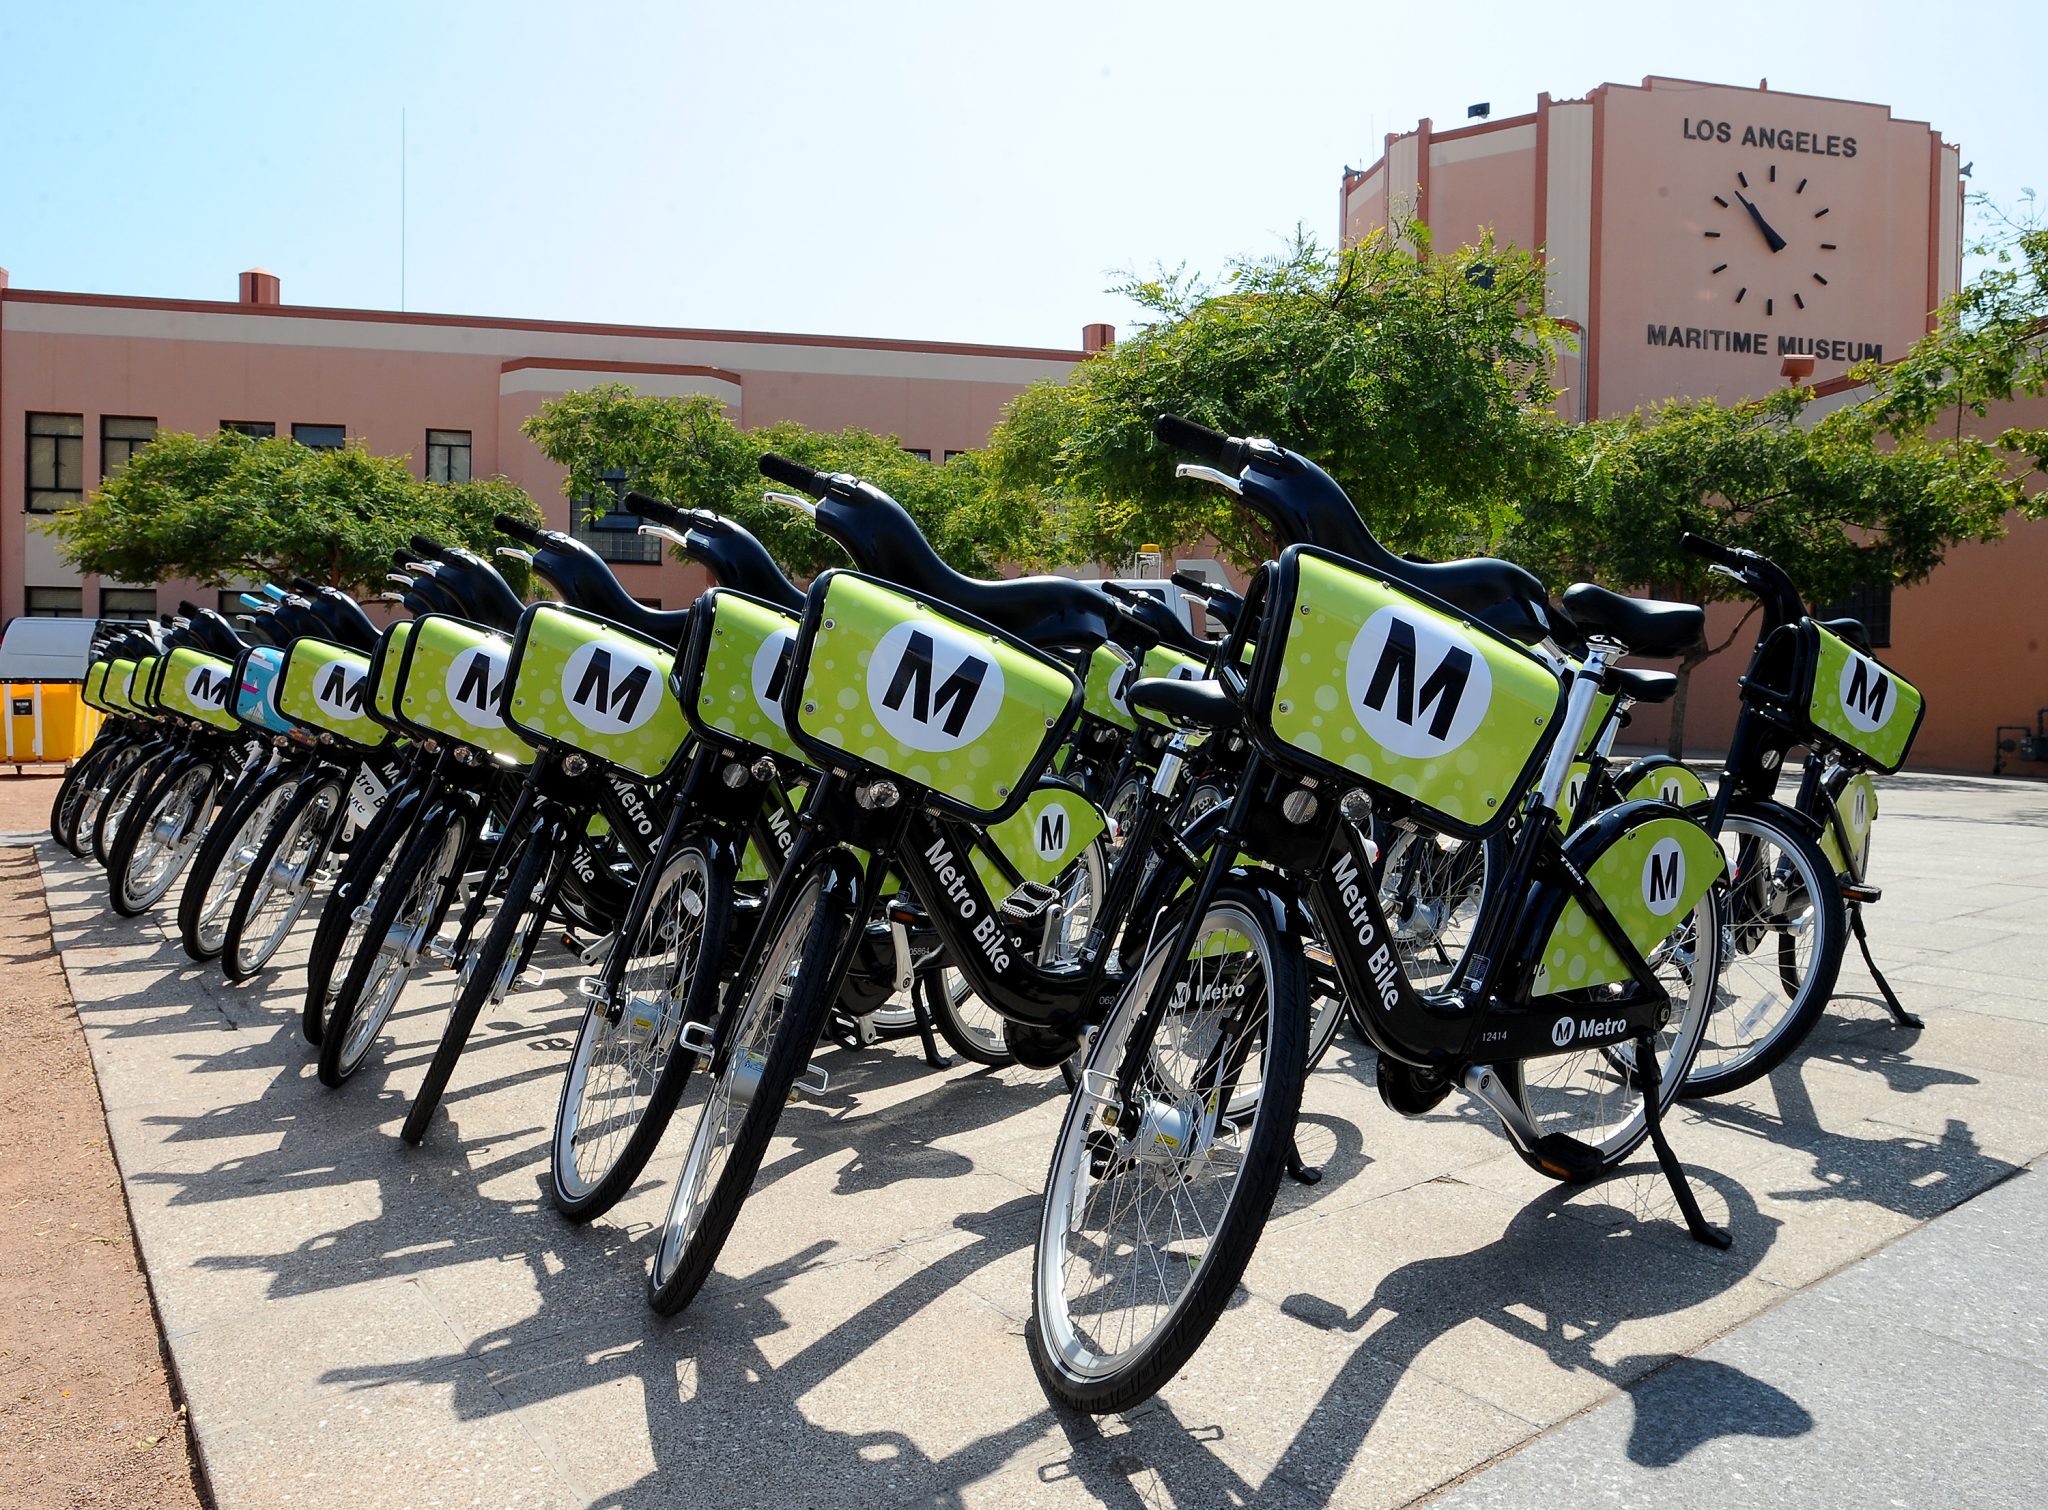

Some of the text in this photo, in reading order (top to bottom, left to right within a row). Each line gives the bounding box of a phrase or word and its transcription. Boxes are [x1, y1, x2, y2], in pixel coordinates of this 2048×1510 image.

[1683, 117, 1858, 159] LOS ANGELES
[1646, 323, 1883, 364] MARITIME MUSEUM
[190, 668, 229, 706] M
[320, 664, 367, 714] M
[572, 647, 653, 725] M
[881, 629, 989, 739] M
[1363, 617, 1473, 741] M
[1846, 657, 1889, 724] M
[609, 777, 653, 835] Metro
[767, 806, 795, 859] Met
[1040, 814, 1064, 852] M
[1171, 835, 1198, 863] TREK
[1559, 855, 1585, 886] TREK
[1649, 851, 1679, 903] M
[924, 837, 1010, 973] Metro Bike
[1331, 851, 1399, 1012] Metro Bike
[1195, 983, 1245, 1002] Metro
[1482, 1031, 1508, 1042] 12414
[1553, 1018, 1627, 1045] M Metro
